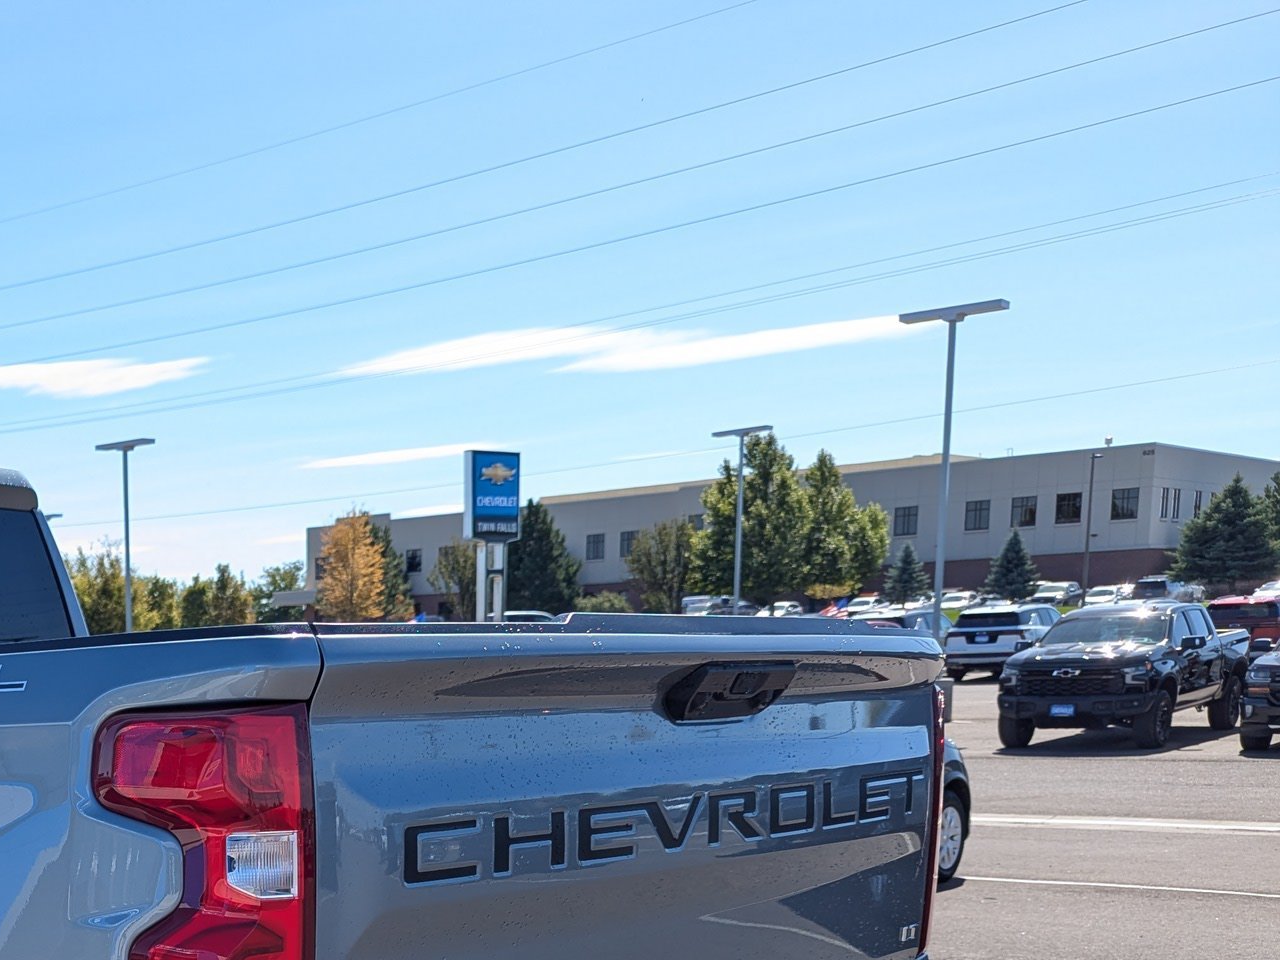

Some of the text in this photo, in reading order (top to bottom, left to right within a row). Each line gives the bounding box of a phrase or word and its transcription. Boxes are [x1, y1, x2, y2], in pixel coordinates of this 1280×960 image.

[476, 496, 517, 507] CHEVROLET
[477, 522, 517, 533] TWIN FALLS
[402, 768, 925, 889] CHEVROLET
